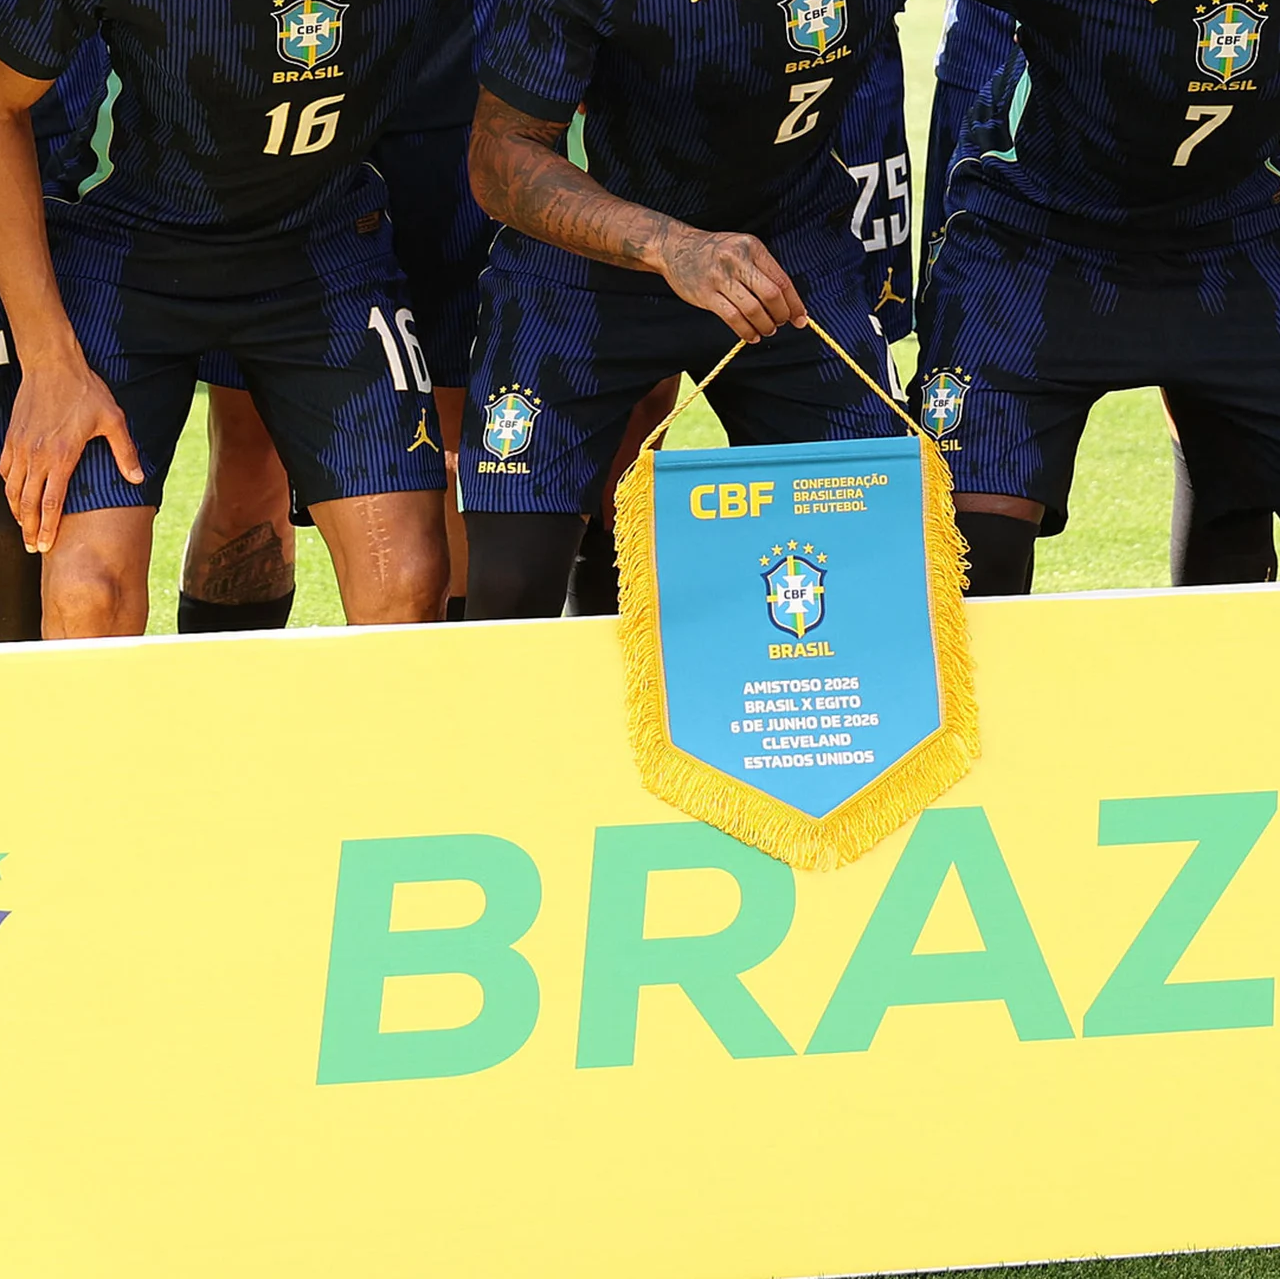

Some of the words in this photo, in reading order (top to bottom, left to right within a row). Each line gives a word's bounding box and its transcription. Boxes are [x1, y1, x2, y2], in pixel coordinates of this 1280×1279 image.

[804, 6, 829, 21] CBF
[296, 23, 324, 35] CBF
[1216, 35, 1243, 48] CBF
[784, 45, 852, 73] BRASIL
[273, 63, 344, 83] BRASIL
[1187, 80, 1257, 94] BRASIL
[773, 77, 834, 145] 2
[262, 93, 345, 157] 16
[1172, 105, 1233, 167] 7
[848, 153, 910, 252] 25
[368, 306, 432, 394] 16
[499, 420, 518, 429] CBF
[478, 461, 531, 474] BRASIL
[793, 473, 888, 490] CONFEDERAÇÃO
[689, 481, 775, 520] CBF
[793, 488, 864, 502] BRASILEIRA
[794, 504, 811, 514] DE
[813, 501, 868, 513] FUTEBOL
[784, 589, 807, 599] CBF
[768, 641, 835, 660] BRASIL
[743, 679, 822, 695] AMISTOSO
[824, 677, 859, 691] 2026
[744, 699, 799, 714] BRASIL
[801, 698, 813, 711] X
[816, 695, 861, 710] EGITO
[730, 721, 740, 733] 6
[743, 719, 764, 733] DE
[766, 716, 818, 731] JUNHO
[821, 714, 842, 729] DE
[844, 713, 880, 727] 2026
[762, 733, 852, 750] CLEVELAND
[743, 753, 814, 769] ESTADOS
[816, 750, 875, 766] UNIDOS
